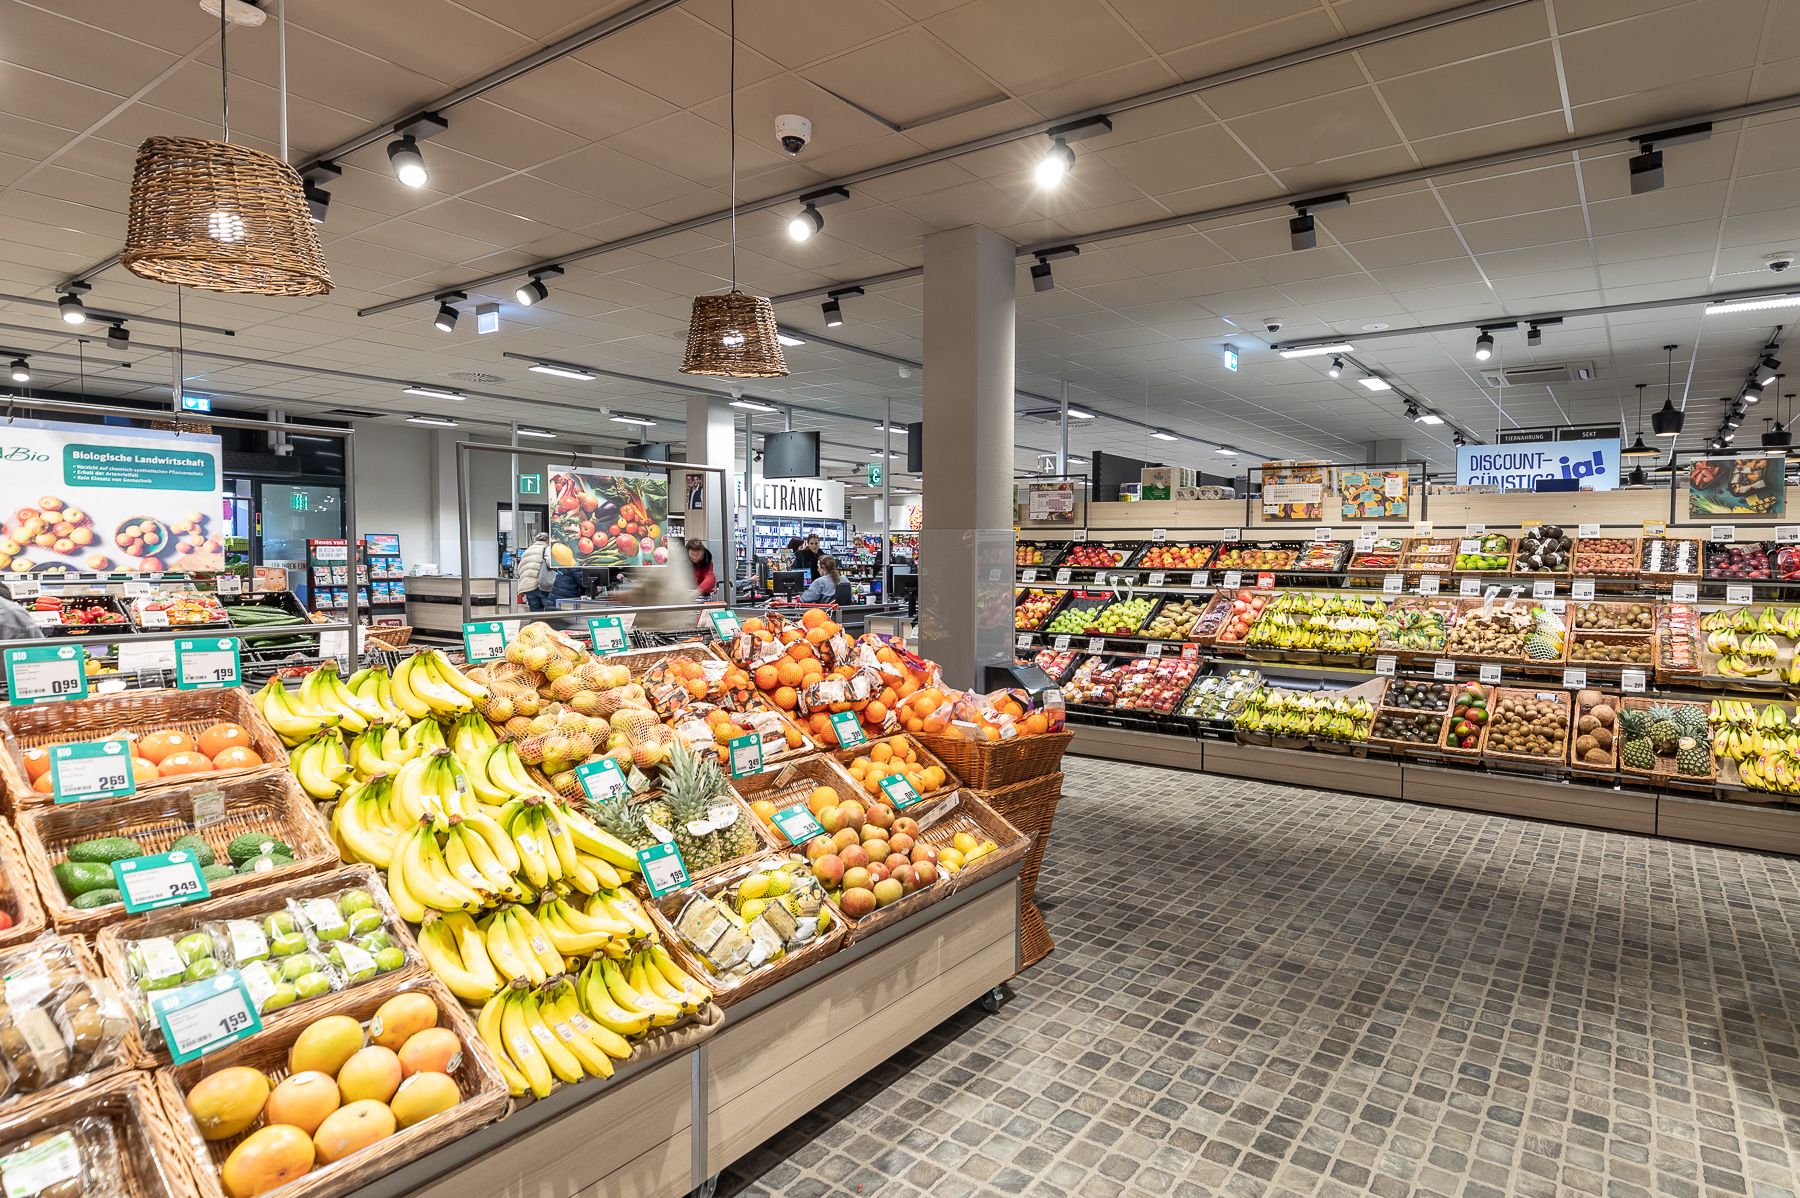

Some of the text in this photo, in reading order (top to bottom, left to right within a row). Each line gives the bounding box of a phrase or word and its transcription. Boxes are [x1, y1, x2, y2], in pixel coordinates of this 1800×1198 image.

[1505, 434, 1544, 442] TIERNAHRUNG
[72, 450, 205, 467] Biologische Landwirtschaft
[1470, 452, 1553, 471] DISCOUNT-
[1558, 450, 1606, 480] ja!
[753, 479, 823, 513] GETRÄNKE
[12, 651, 27, 661] BIO
[213, 668, 233, 681] 1.99
[52, 679, 78, 694] 0.99
[99, 775, 126, 791] 2.69
[670, 869, 684, 884] 1.99
[219, 1010, 248, 1034] 1.59
